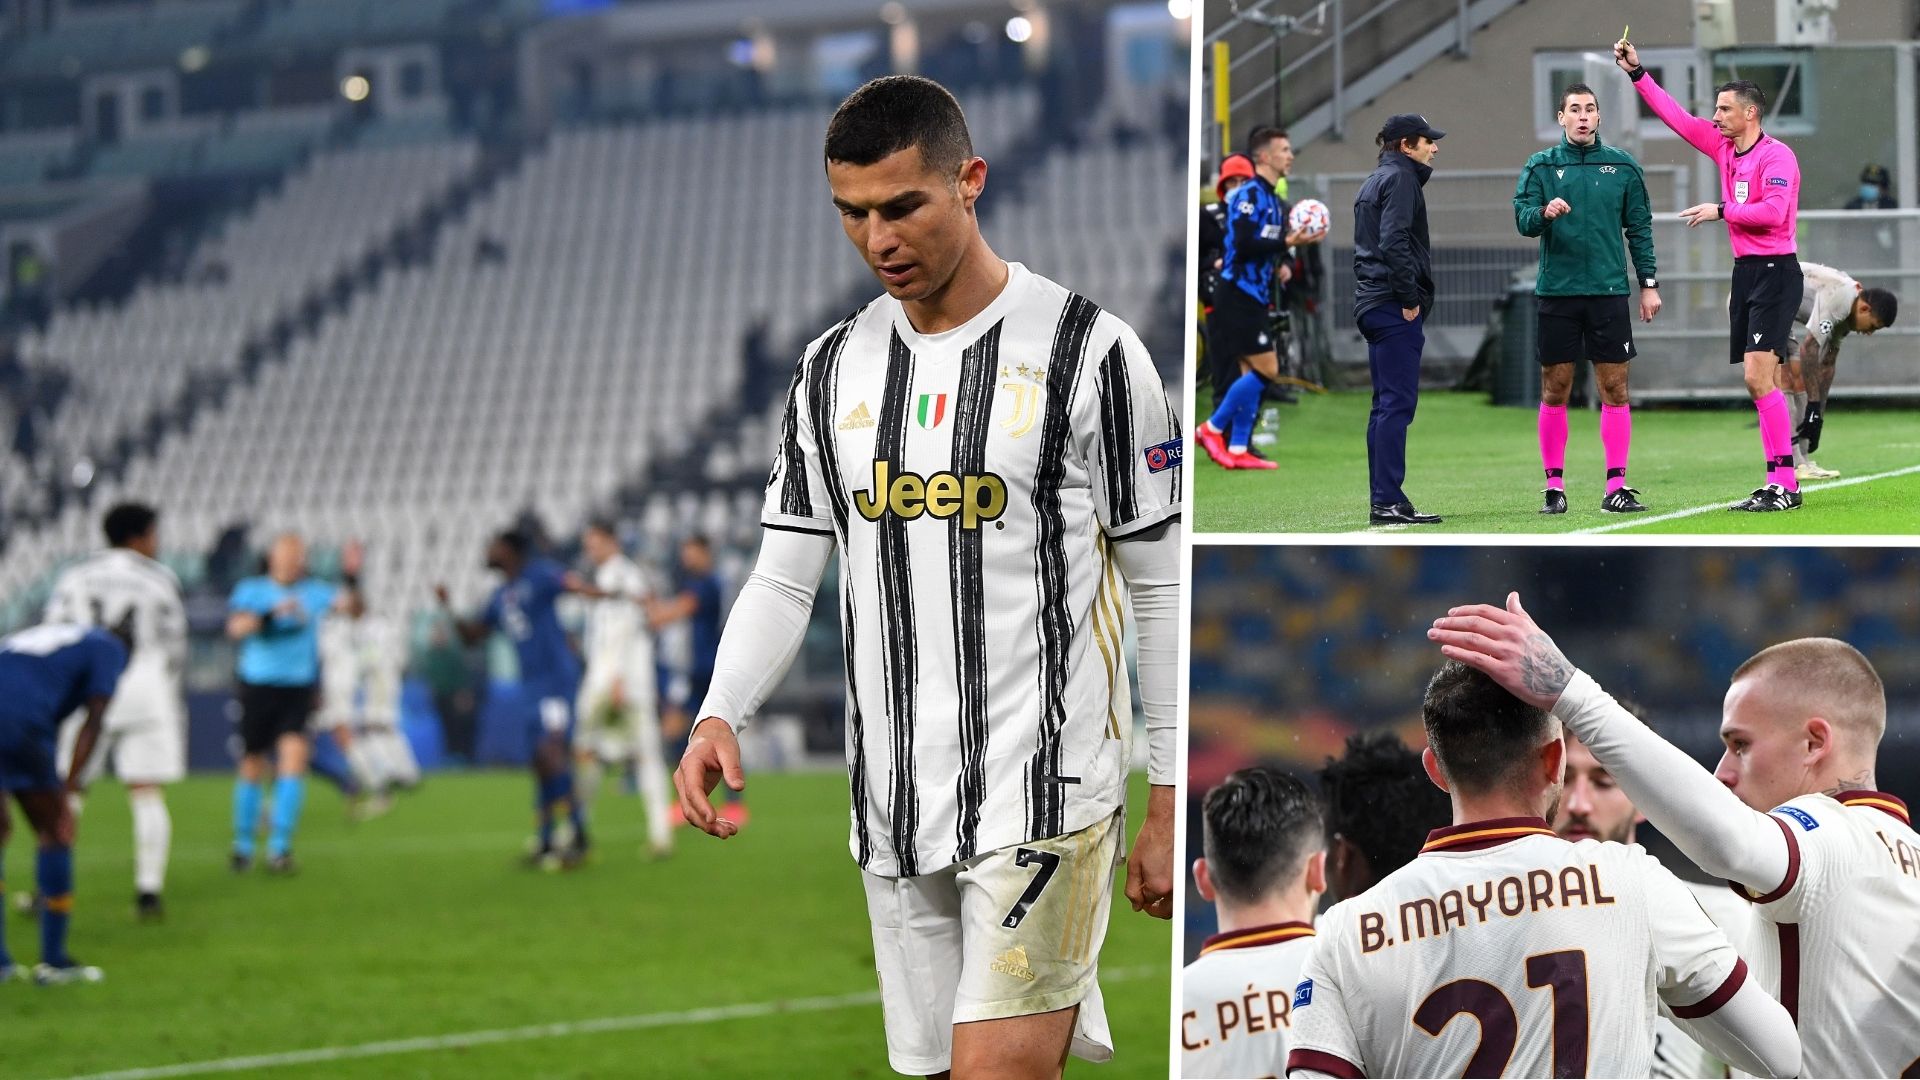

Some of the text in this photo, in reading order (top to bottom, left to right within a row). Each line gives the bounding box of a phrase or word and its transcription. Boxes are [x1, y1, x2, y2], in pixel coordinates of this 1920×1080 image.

[838, 418, 875, 430] adidas
[852, 457, 1007, 530] Jeep
[1001, 847, 1061, 928] 7
[990, 962, 1034, 982] adidas
[1182, 1010, 1209, 1051] C.
[1413, 949, 1589, 1079] 21
